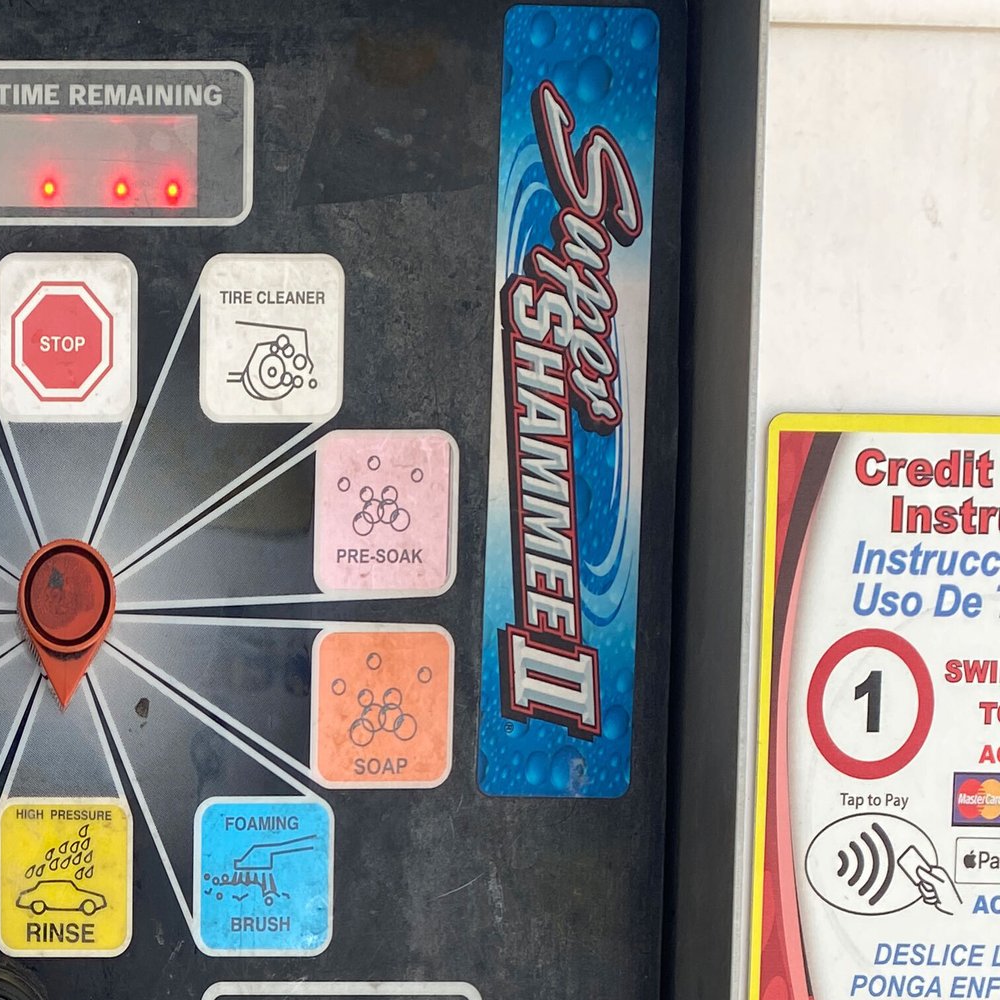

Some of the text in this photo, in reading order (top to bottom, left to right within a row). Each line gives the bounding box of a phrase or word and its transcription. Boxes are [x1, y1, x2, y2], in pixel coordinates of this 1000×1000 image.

[69, 84, 223, 107] REMAINING
[534, 78, 643, 435] Super
[220, 290, 326, 305] TIRE CLEANER
[39, 336, 86, 353] STOP
[855, 447, 994, 488] Credit
[506, 275, 602, 737] SHAMMEE II
[890, 495, 1000, 535] Instr
[336, 549, 423, 564] PRE-SOAK
[852, 540, 1000, 577] Instrucc
[853, 582, 922, 617] Uso
[933, 583, 982, 618] De
[944, 659, 1000, 684] SWI
[854, 670, 882, 733] 1
[354, 758, 409, 775] SOAP
[840, 793, 909, 810] Tap to Pay
[16, 809, 112, 821] HIGH PRESSURE
[225, 816, 300, 831] FOAMING
[26, 923, 96, 943] RINSE
[231, 917, 291, 932] BRUSH
[874, 943, 986, 967] DESLICE
[850, 975, 942, 998] PONGA
